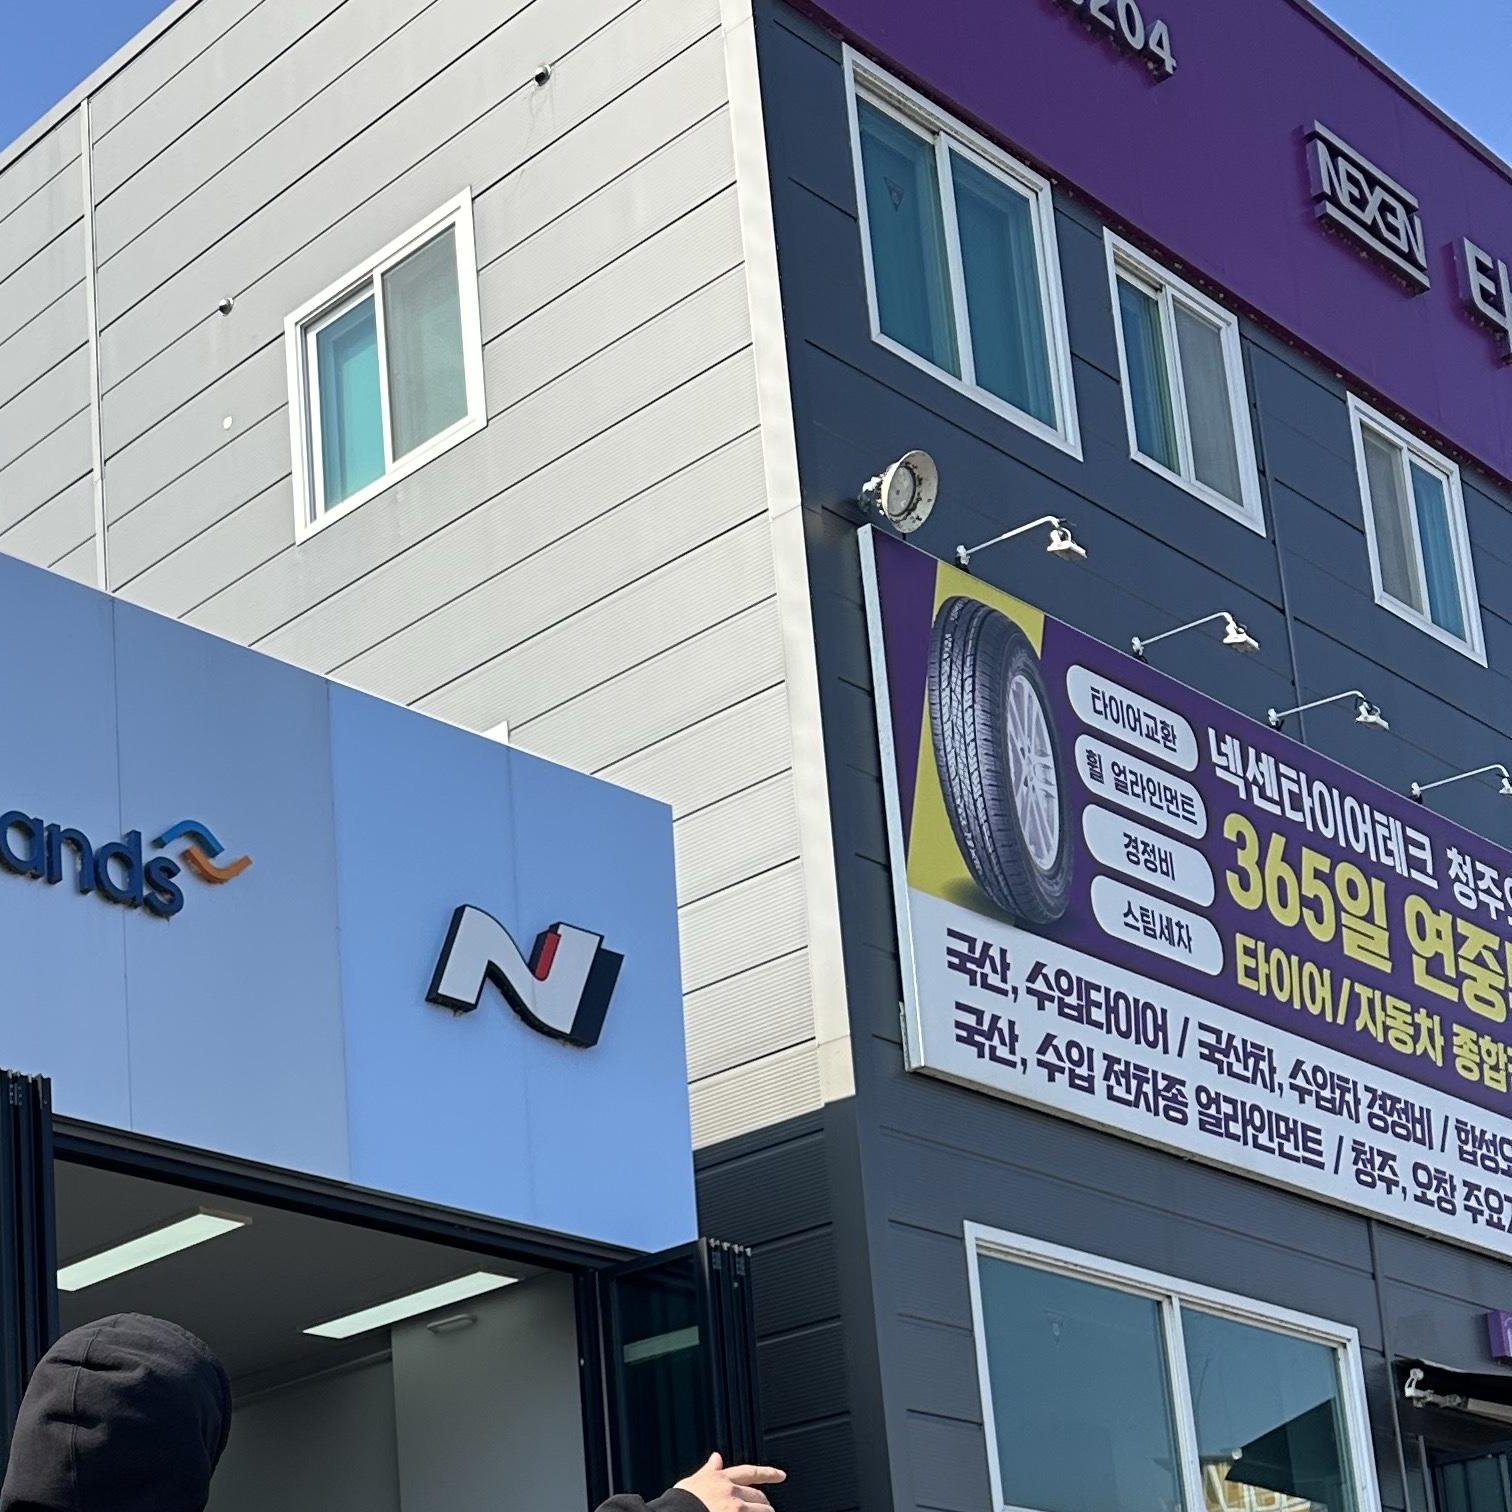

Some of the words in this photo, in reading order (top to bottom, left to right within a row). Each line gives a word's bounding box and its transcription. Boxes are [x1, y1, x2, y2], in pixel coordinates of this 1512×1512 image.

[1071, 0, 1177, 75] 204
[1090, 686, 1177, 753] 타이어교환
[1085, 748, 1105, 785] 휠
[1111, 760, 1198, 826] 얼라인먼트
[1207, 726, 1438, 890] 넥센타이어테크
[1123, 831, 1175, 881] 경정비
[1123, 900, 1192, 954] 스팀세차
[1223, 812, 1393, 974] 365일
[1404, 893, 1512, 1023] 연중
[426, 903, 625, 1049] N
[946, 927, 1019, 1003] 국산,
[1025, 960, 1170, 1055] 수입타이어
[1197, 1020, 1284, 1098] 국산차,
[1288, 1058, 1361, 1123] 수입차
[1363, 1084, 1434, 1150] 경정비
[1452, 1023, 1512, 1093] 종합
[954, 1000, 1028, 1076] 국산,
[1036, 1032, 1096, 1096] 수입
[1101, 1052, 1189, 1126] 전차종
[1195, 1084, 1326, 1171] 얼라인먼트
[1351, 1139, 1407, 1202] 청주,
[1412, 1161, 1457, 1216] 오창
[1461, 1179, 1512, 1234] 주요
